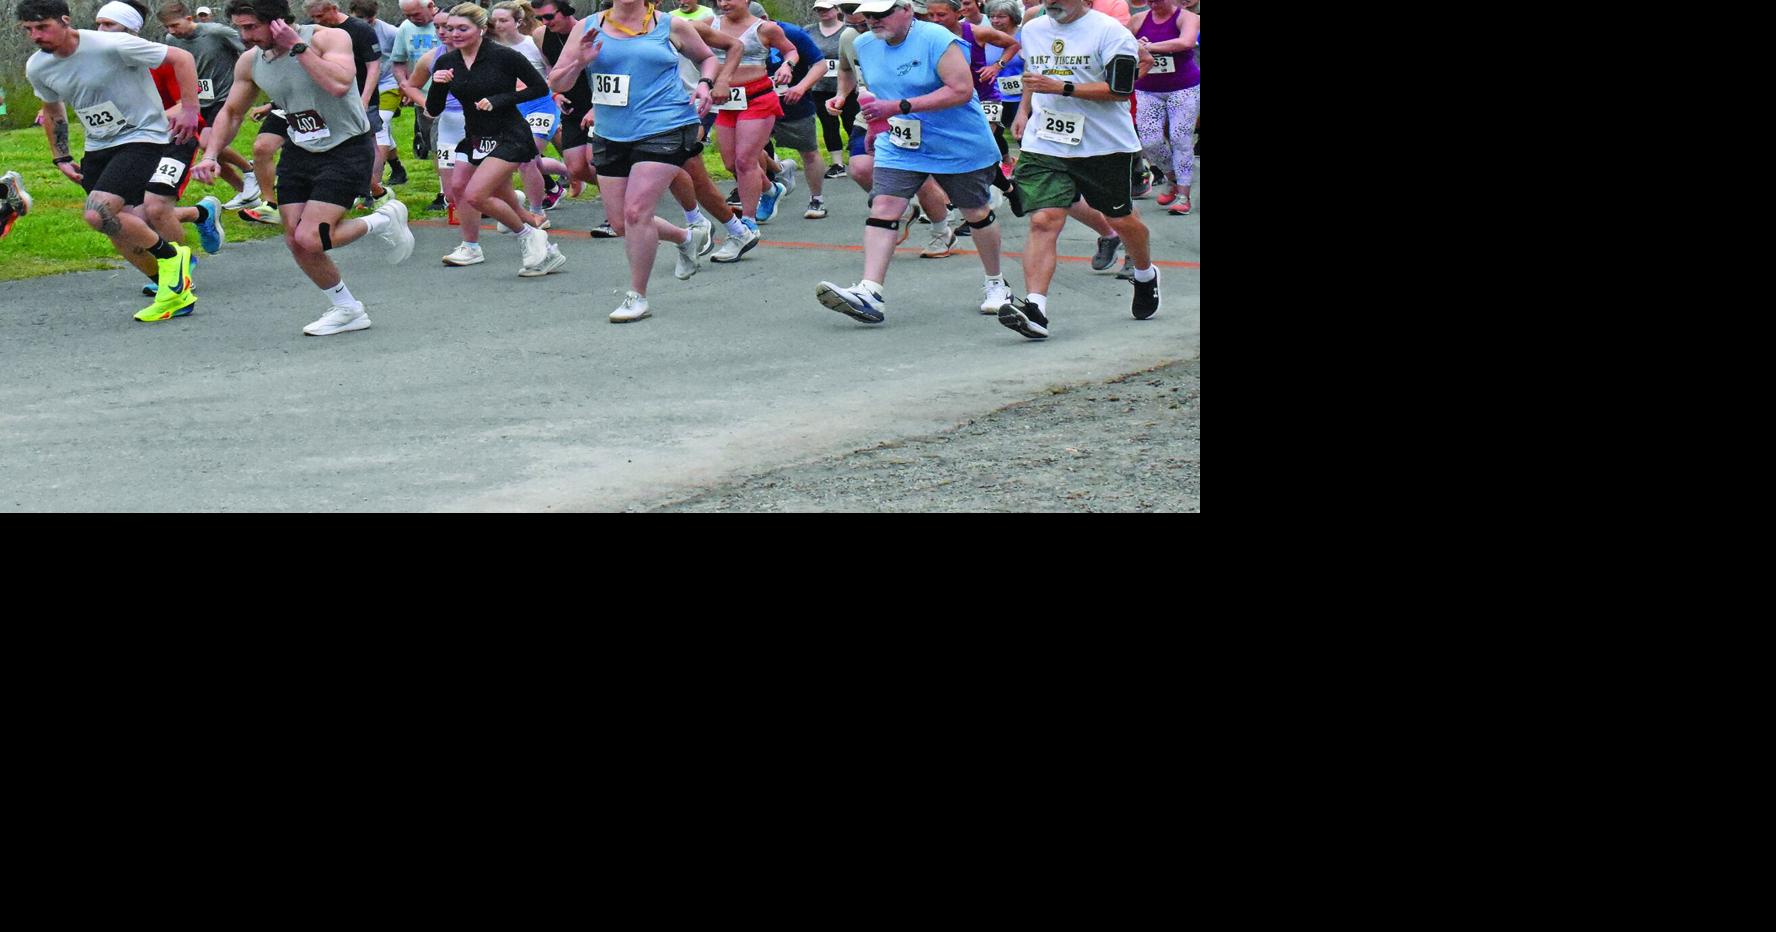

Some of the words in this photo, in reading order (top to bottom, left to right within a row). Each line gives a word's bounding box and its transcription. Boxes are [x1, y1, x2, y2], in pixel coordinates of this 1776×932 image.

[597, 75, 621, 94] 361
[1002, 80, 1020, 90] 288
[983, 104, 998, 114] 53
[86, 111, 114, 126] 223
[297, 116, 320, 132] 402
[529, 118, 550, 128] 236
[1046, 118, 1076, 134] 295
[480, 139, 497, 152] 402
[160, 164, 177, 177] 42
